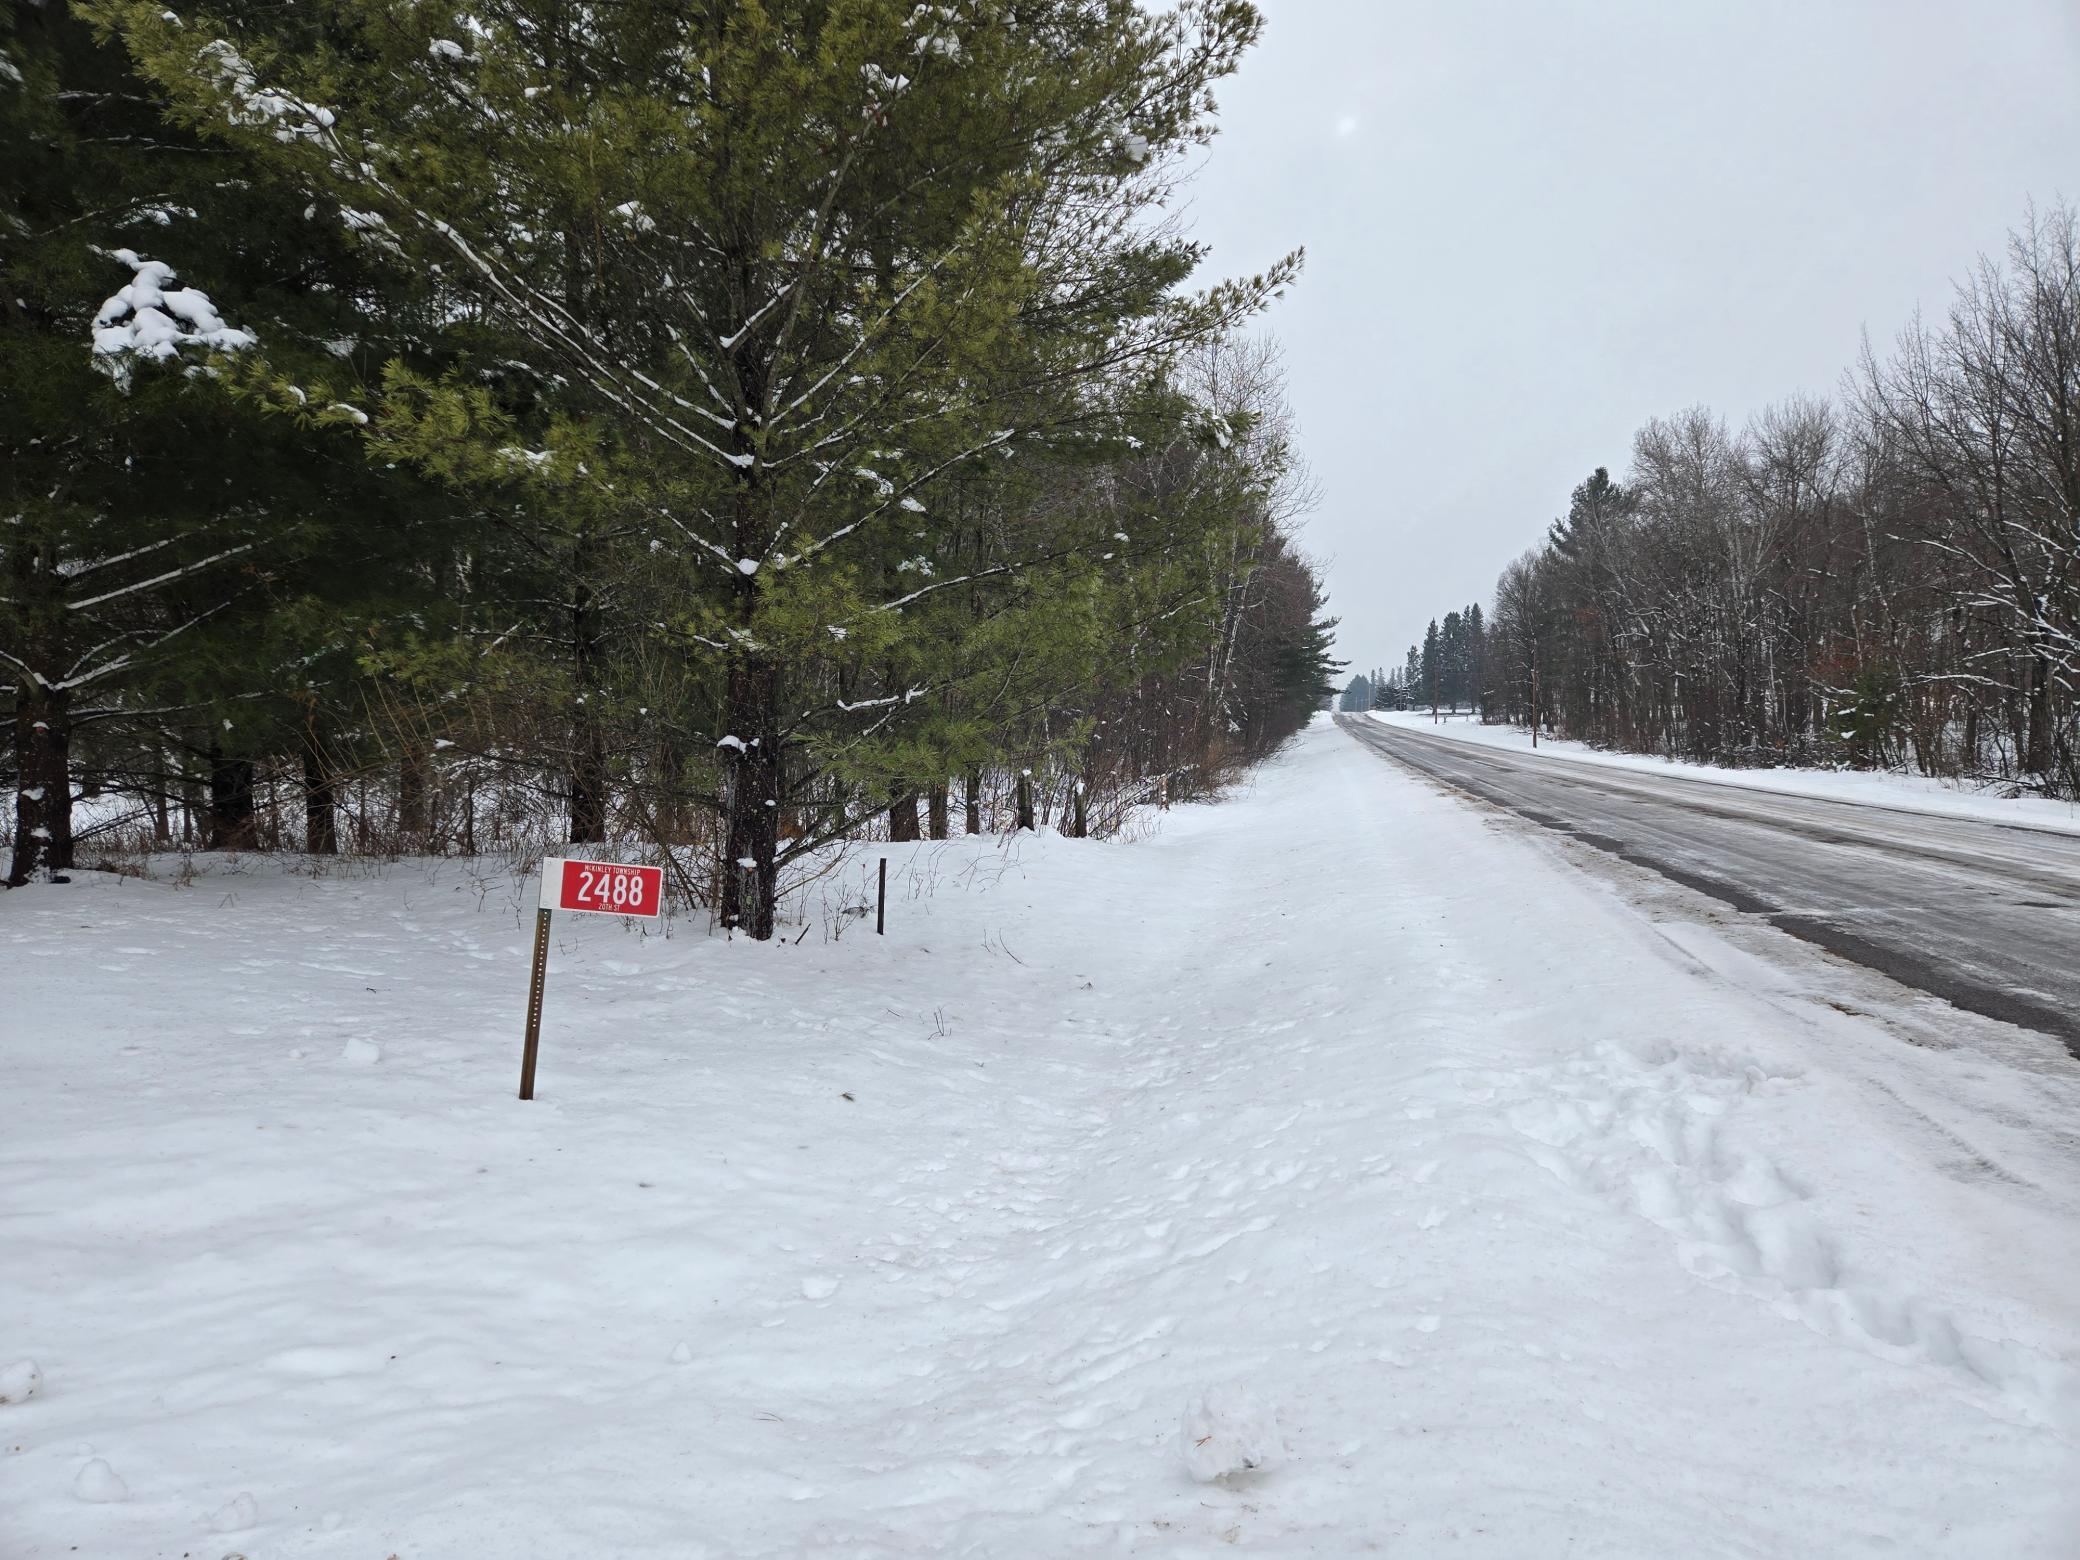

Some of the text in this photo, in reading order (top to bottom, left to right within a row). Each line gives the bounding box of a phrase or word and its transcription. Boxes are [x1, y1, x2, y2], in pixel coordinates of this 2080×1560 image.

[613, 866, 641, 876] TOWNSHIP
[577, 871, 643, 906] 2488
[598, 903, 620, 912] 20TH ST
